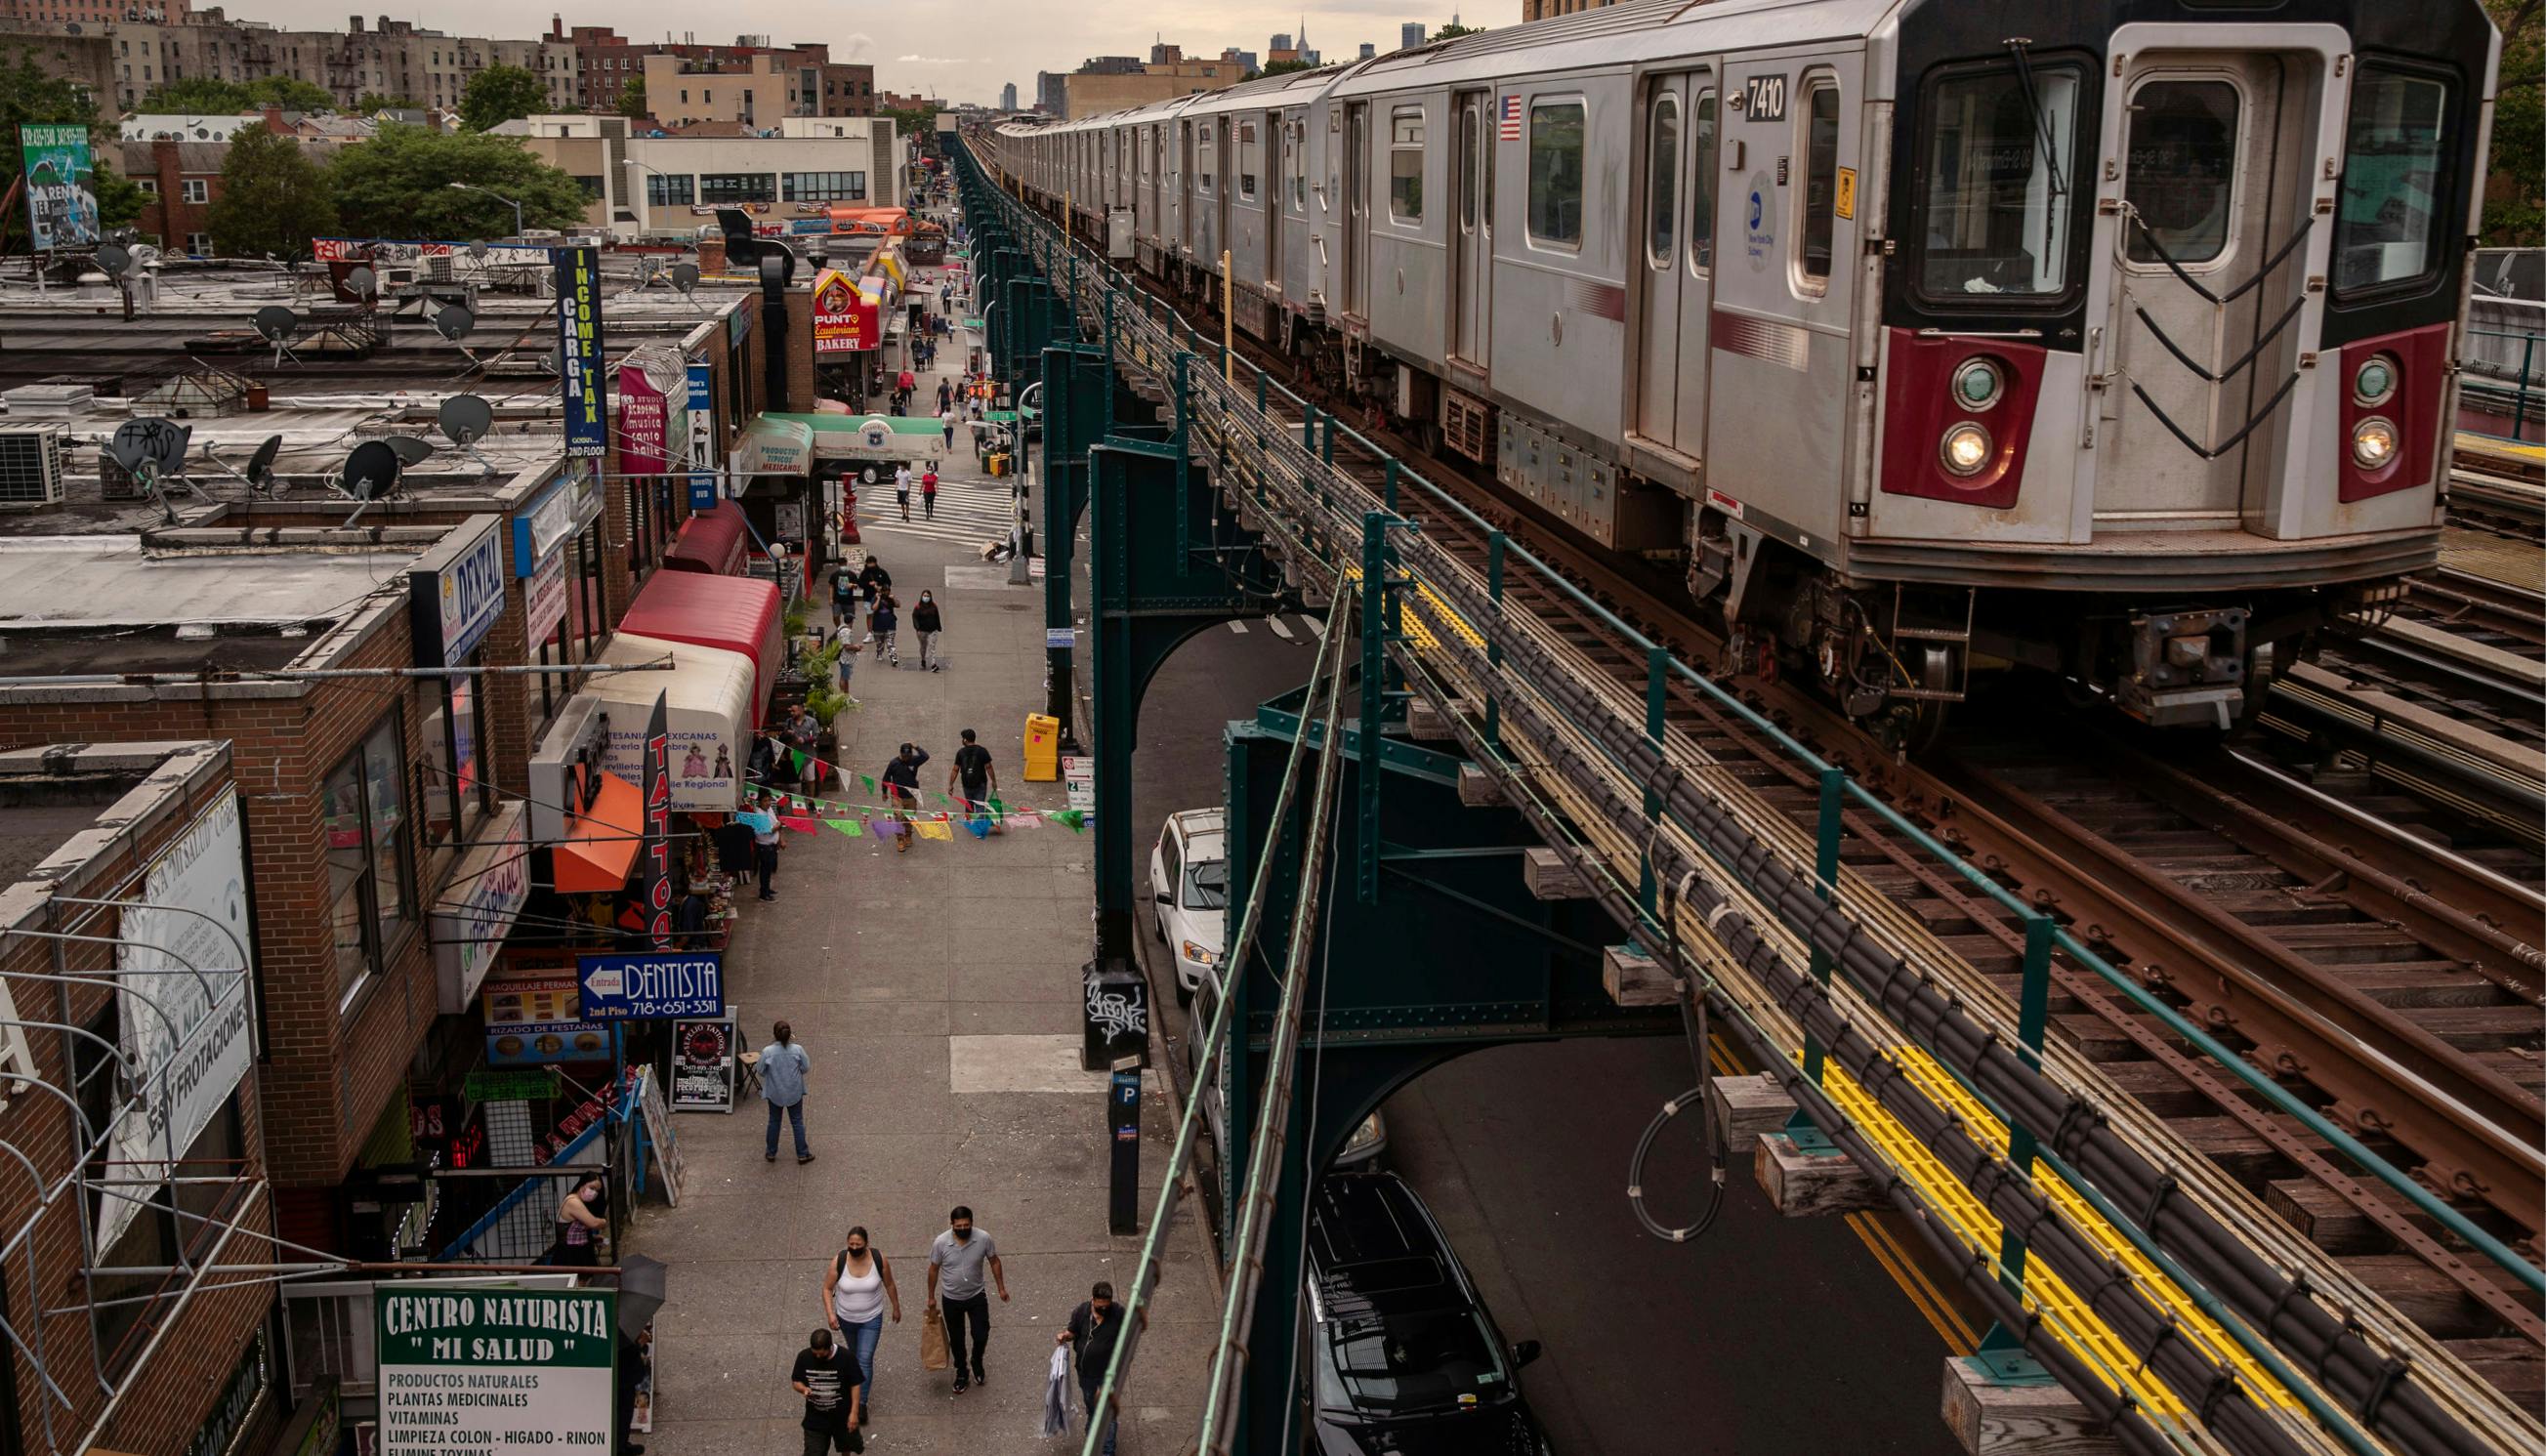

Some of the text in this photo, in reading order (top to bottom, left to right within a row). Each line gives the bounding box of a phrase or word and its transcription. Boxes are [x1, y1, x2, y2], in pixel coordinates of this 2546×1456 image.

[1749, 78, 1783, 118] 7410
[575, 249, 594, 357] INCOME
[563, 297, 582, 397] CARGA
[816, 338, 859, 352] BAKERY
[583, 368, 598, 423] TAX
[568, 446, 605, 456] 2ND FLOOR
[632, 442, 661, 456] baile
[761, 446, 800, 456] PRODUCTOS
[767, 455, 793, 464] TIPICOS
[762, 463, 802, 474] MEXICANOS
[457, 534, 501, 627] DENTAL
[666, 731, 718, 742] EXICANAS
[685, 780, 729, 792] Regional
[488, 981, 541, 991] MAQUILLAJE
[591, 978, 620, 987] Entrada
[625, 962, 718, 1000] DENTISTA
[589, 1007, 605, 1017] 2nd
[608, 1006, 628, 1016] Piso
[490, 1026, 531, 1035] RIZADO
[1124, 1088, 1135, 1102] P
[386, 1297, 608, 1340] CENTRO NATURISTA
[433, 1338, 462, 1359] MI
[472, 1338, 555, 1361] SALUD
[389, 1374, 539, 1389] PRODUCTOS NATURALES
[226, 1360, 256, 1433] SALON
[388, 1394, 528, 1406] PLANTAS MEDICINALES
[389, 1412, 459, 1425] VITAMINAS
[388, 1431, 446, 1444] LIMPIEZA
[450, 1431, 492, 1444] COLON
[504, 1432, 554, 1444] HIGADO
[567, 1432, 605, 1444] RINON
